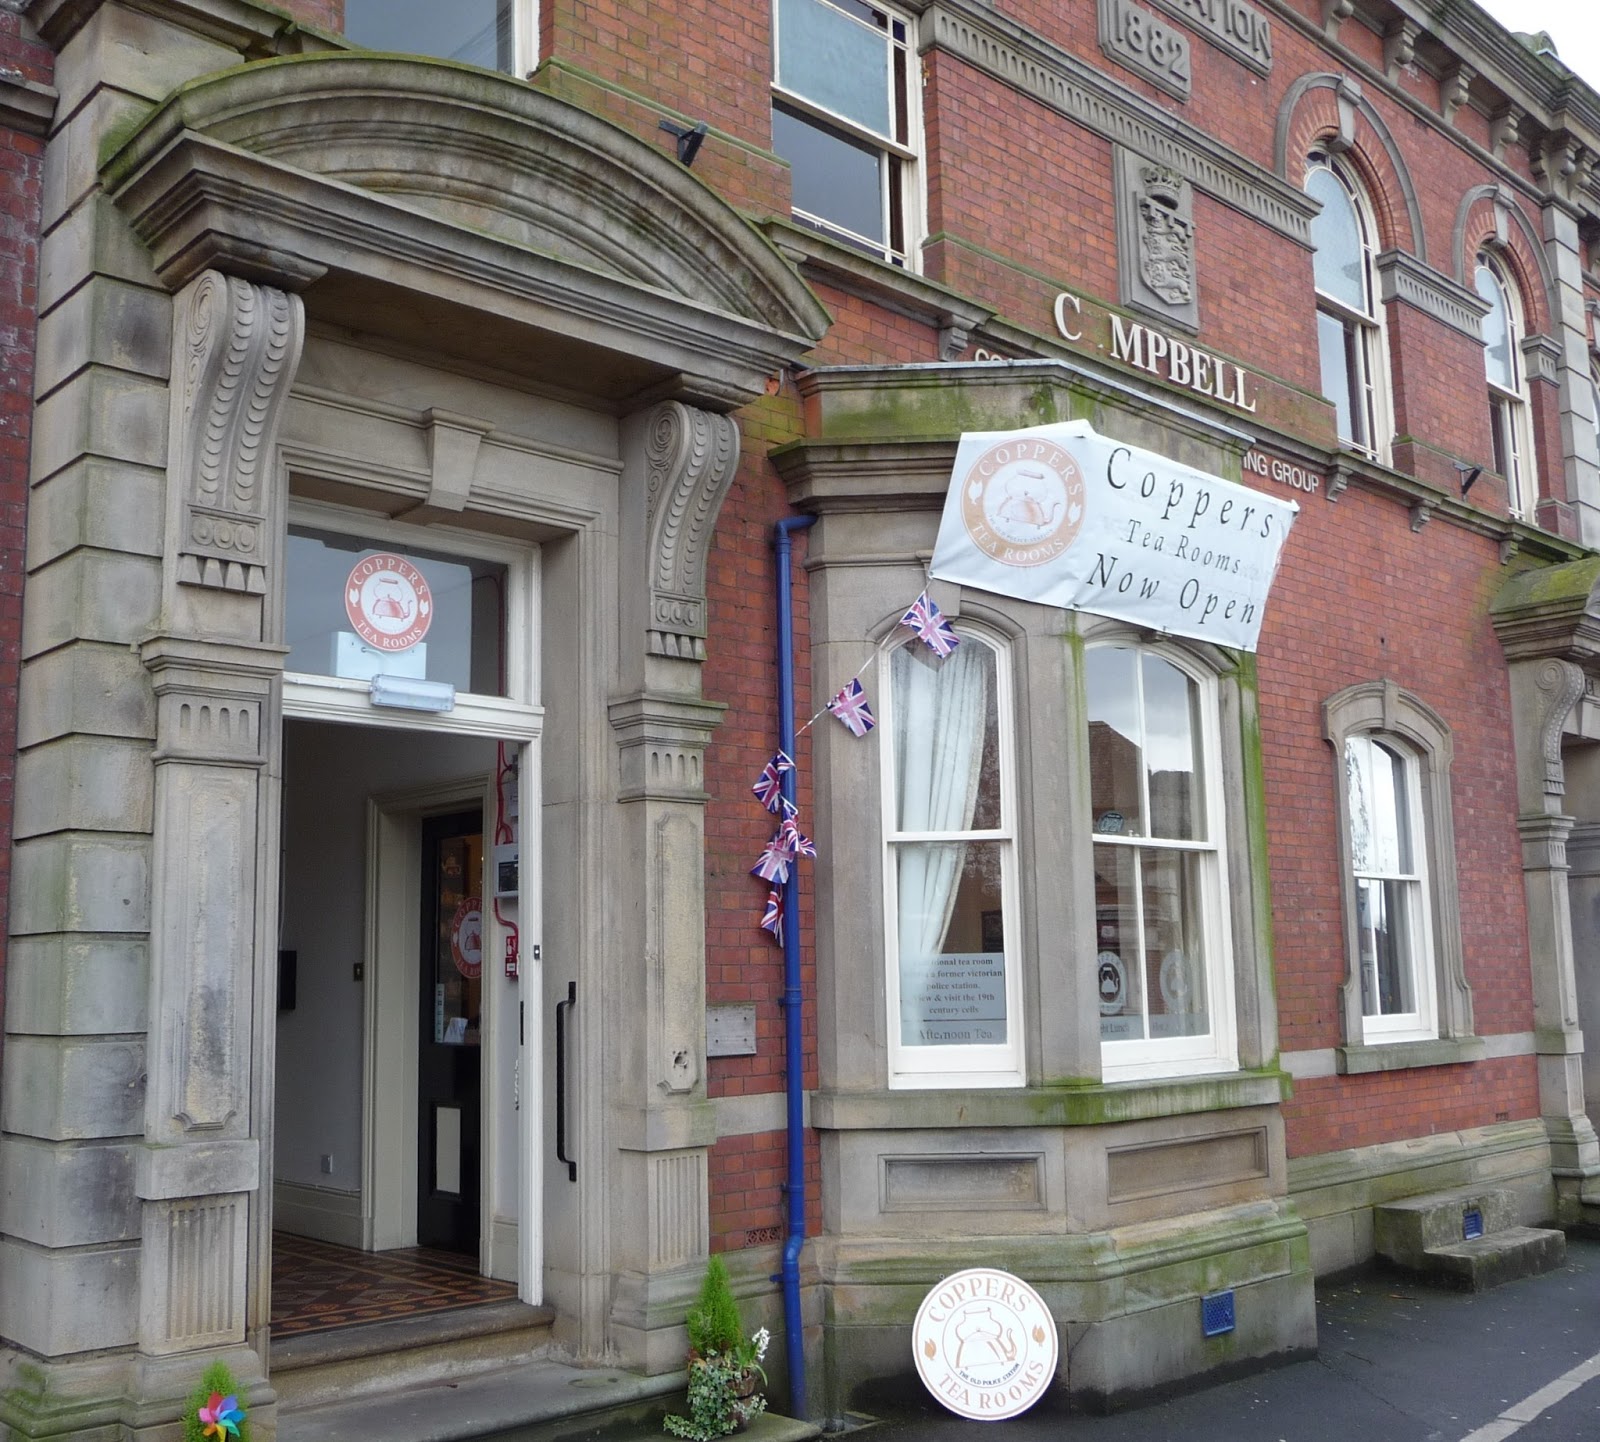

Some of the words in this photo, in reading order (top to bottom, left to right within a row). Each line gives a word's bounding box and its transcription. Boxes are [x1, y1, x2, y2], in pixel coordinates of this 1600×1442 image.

[1115, 0, 1189, 82] 1882
[979, 443, 1082, 496] COPPERS
[1271, 460, 1320, 493] GROUP
[1106, 447, 1274, 539] Coppers
[972, 521, 998, 552] TEA
[1004, 538, 1065, 562] ROOMS
[1126, 518, 1164, 552] Tea
[1175, 534, 1242, 575] Rooms
[352, 558, 427, 595] COPPERS
[1086, 553, 1160, 600] Now
[1179, 578, 1256, 625] Open
[357, 619, 378, 643] TEA
[382, 627, 423, 648] ROOMS
[455, 900, 483, 928] COPP
[937, 969, 965, 978] former
[967, 969, 1003, 978] victorian
[958, 958, 971, 966] tea
[972, 958, 993, 966] room
[926, 983, 950, 992] police
[944, 993, 961, 1002] visit
[962, 993, 975, 1001] the
[978, 992, 995, 1001] 19th
[929, 1006, 959, 1016] century
[919, 1027, 971, 1040] Afternoon
[975, 1027, 993, 1040] Tea
[928, 1277, 1032, 1323] COPPERS
[938, 1373, 971, 1407] TEA
[979, 1360, 1044, 1409] ROOMS
